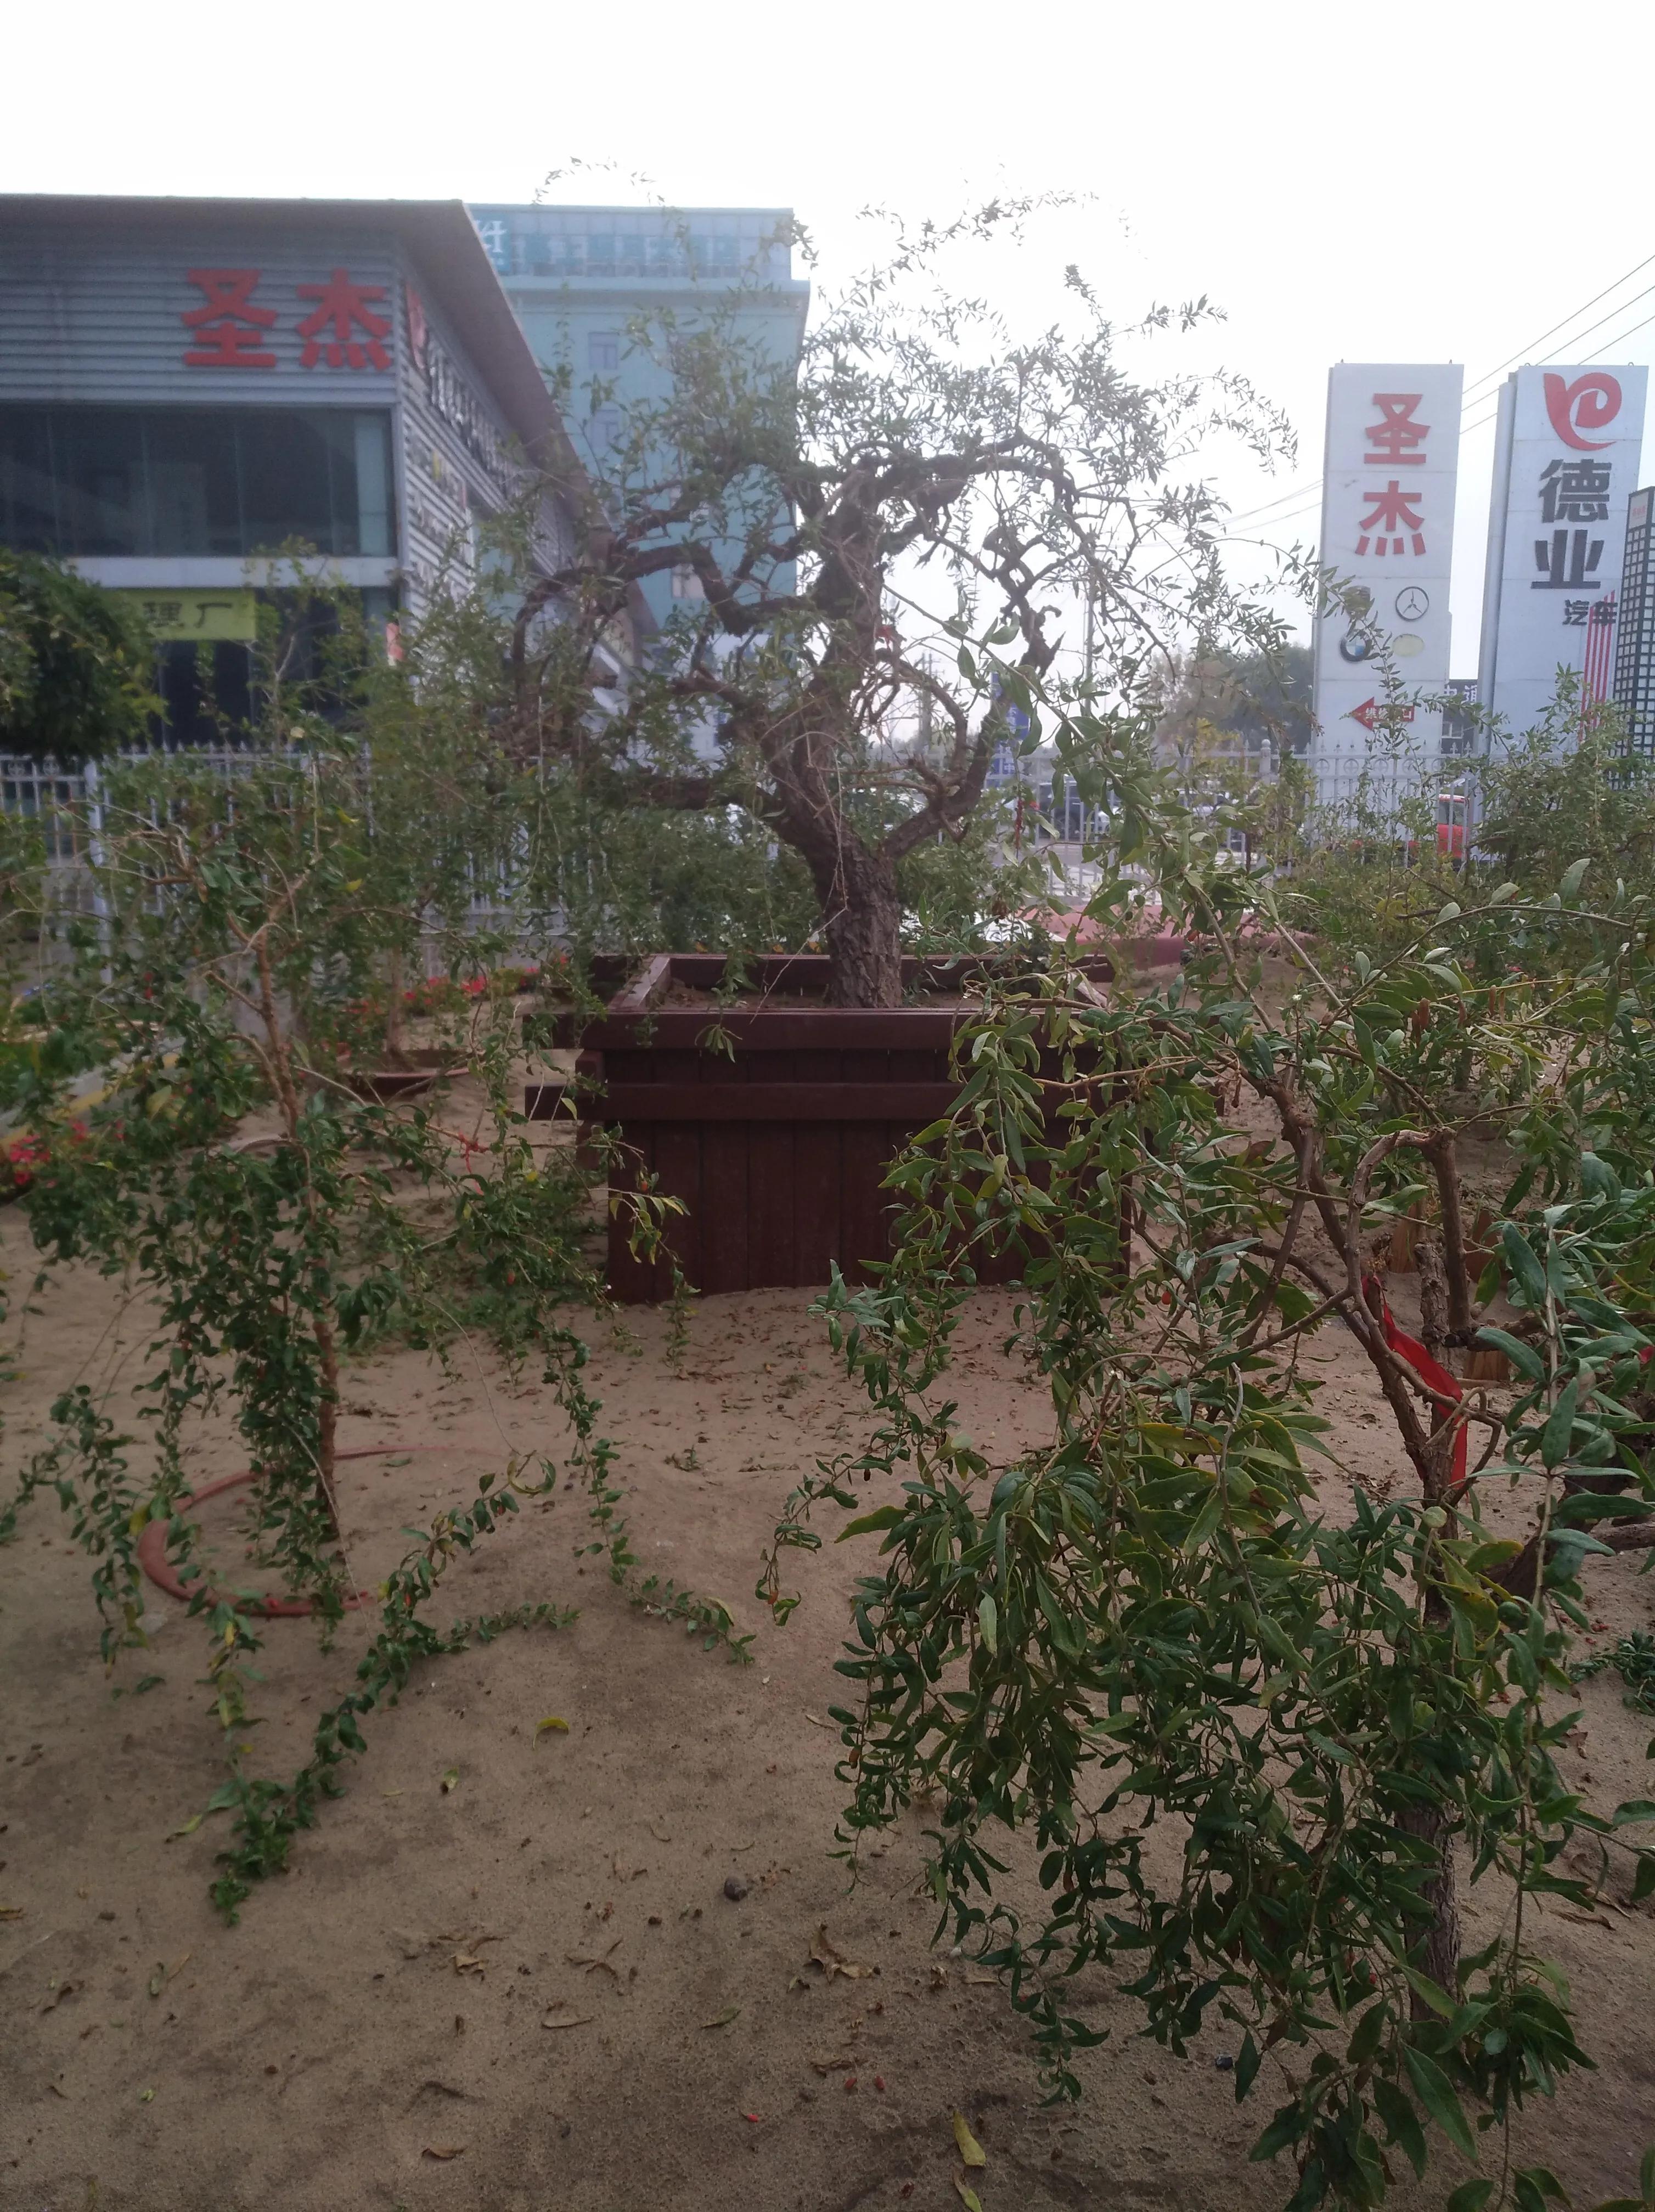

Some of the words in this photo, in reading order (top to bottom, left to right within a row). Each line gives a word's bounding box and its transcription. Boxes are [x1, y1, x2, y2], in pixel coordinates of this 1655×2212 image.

[181, 268, 393, 370] 圣杰
[1355, 393, 1431, 556] 圣杰
[1530, 459, 1612, 589] 德业
[1562, 599, 1618, 626] 汽车
